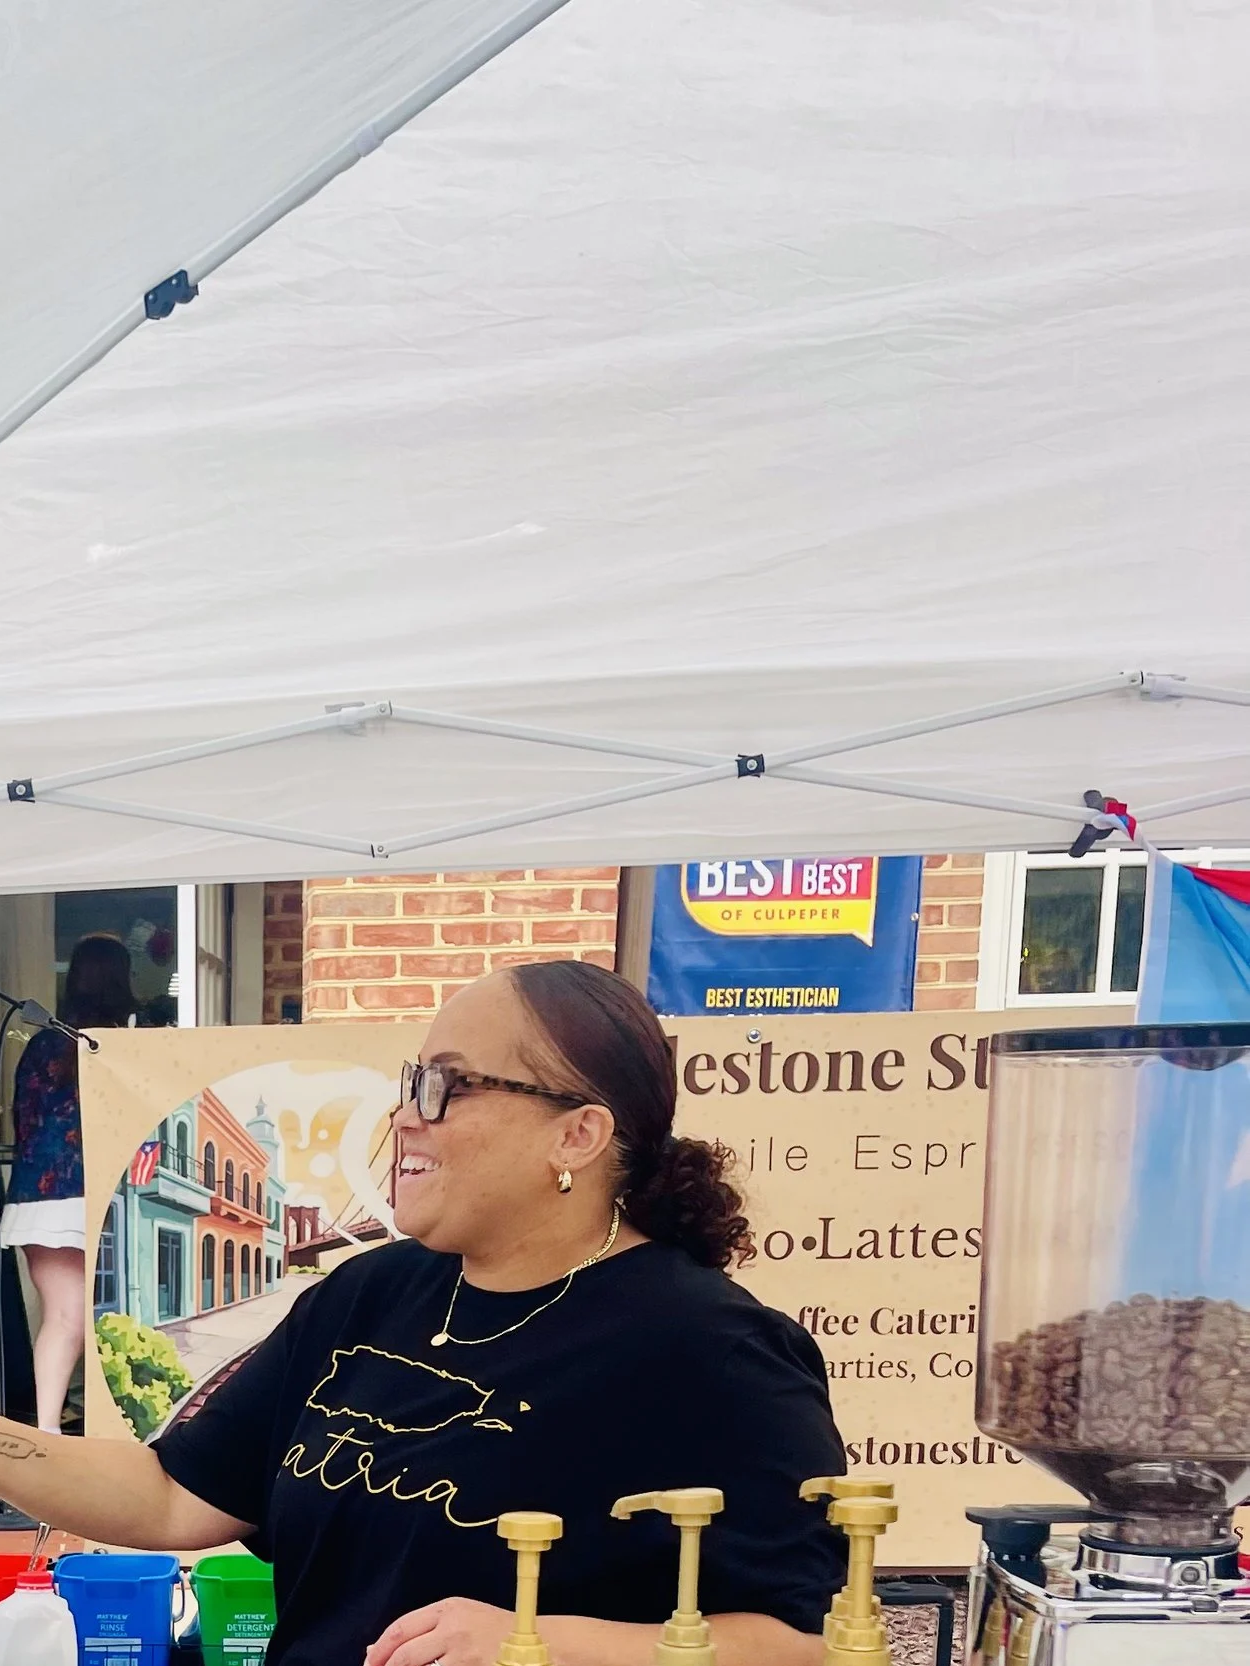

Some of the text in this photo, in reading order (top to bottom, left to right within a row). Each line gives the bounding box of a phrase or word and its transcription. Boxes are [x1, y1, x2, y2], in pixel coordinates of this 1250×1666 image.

[802, 864, 863, 896] BEST
[721, 908, 841, 922] OF CULPEPER
[705, 987, 840, 1008] BEST ESTHETICIAN
[732, 1134, 977, 1175] ile Espr
[870, 1304, 977, 1336] Cateri
[928, 1351, 974, 1379] Co
[280, 1427, 499, 1528] atria
[100, 1623, 126, 1632] RINSE
[226, 1623, 275, 1632] DETERGENT
